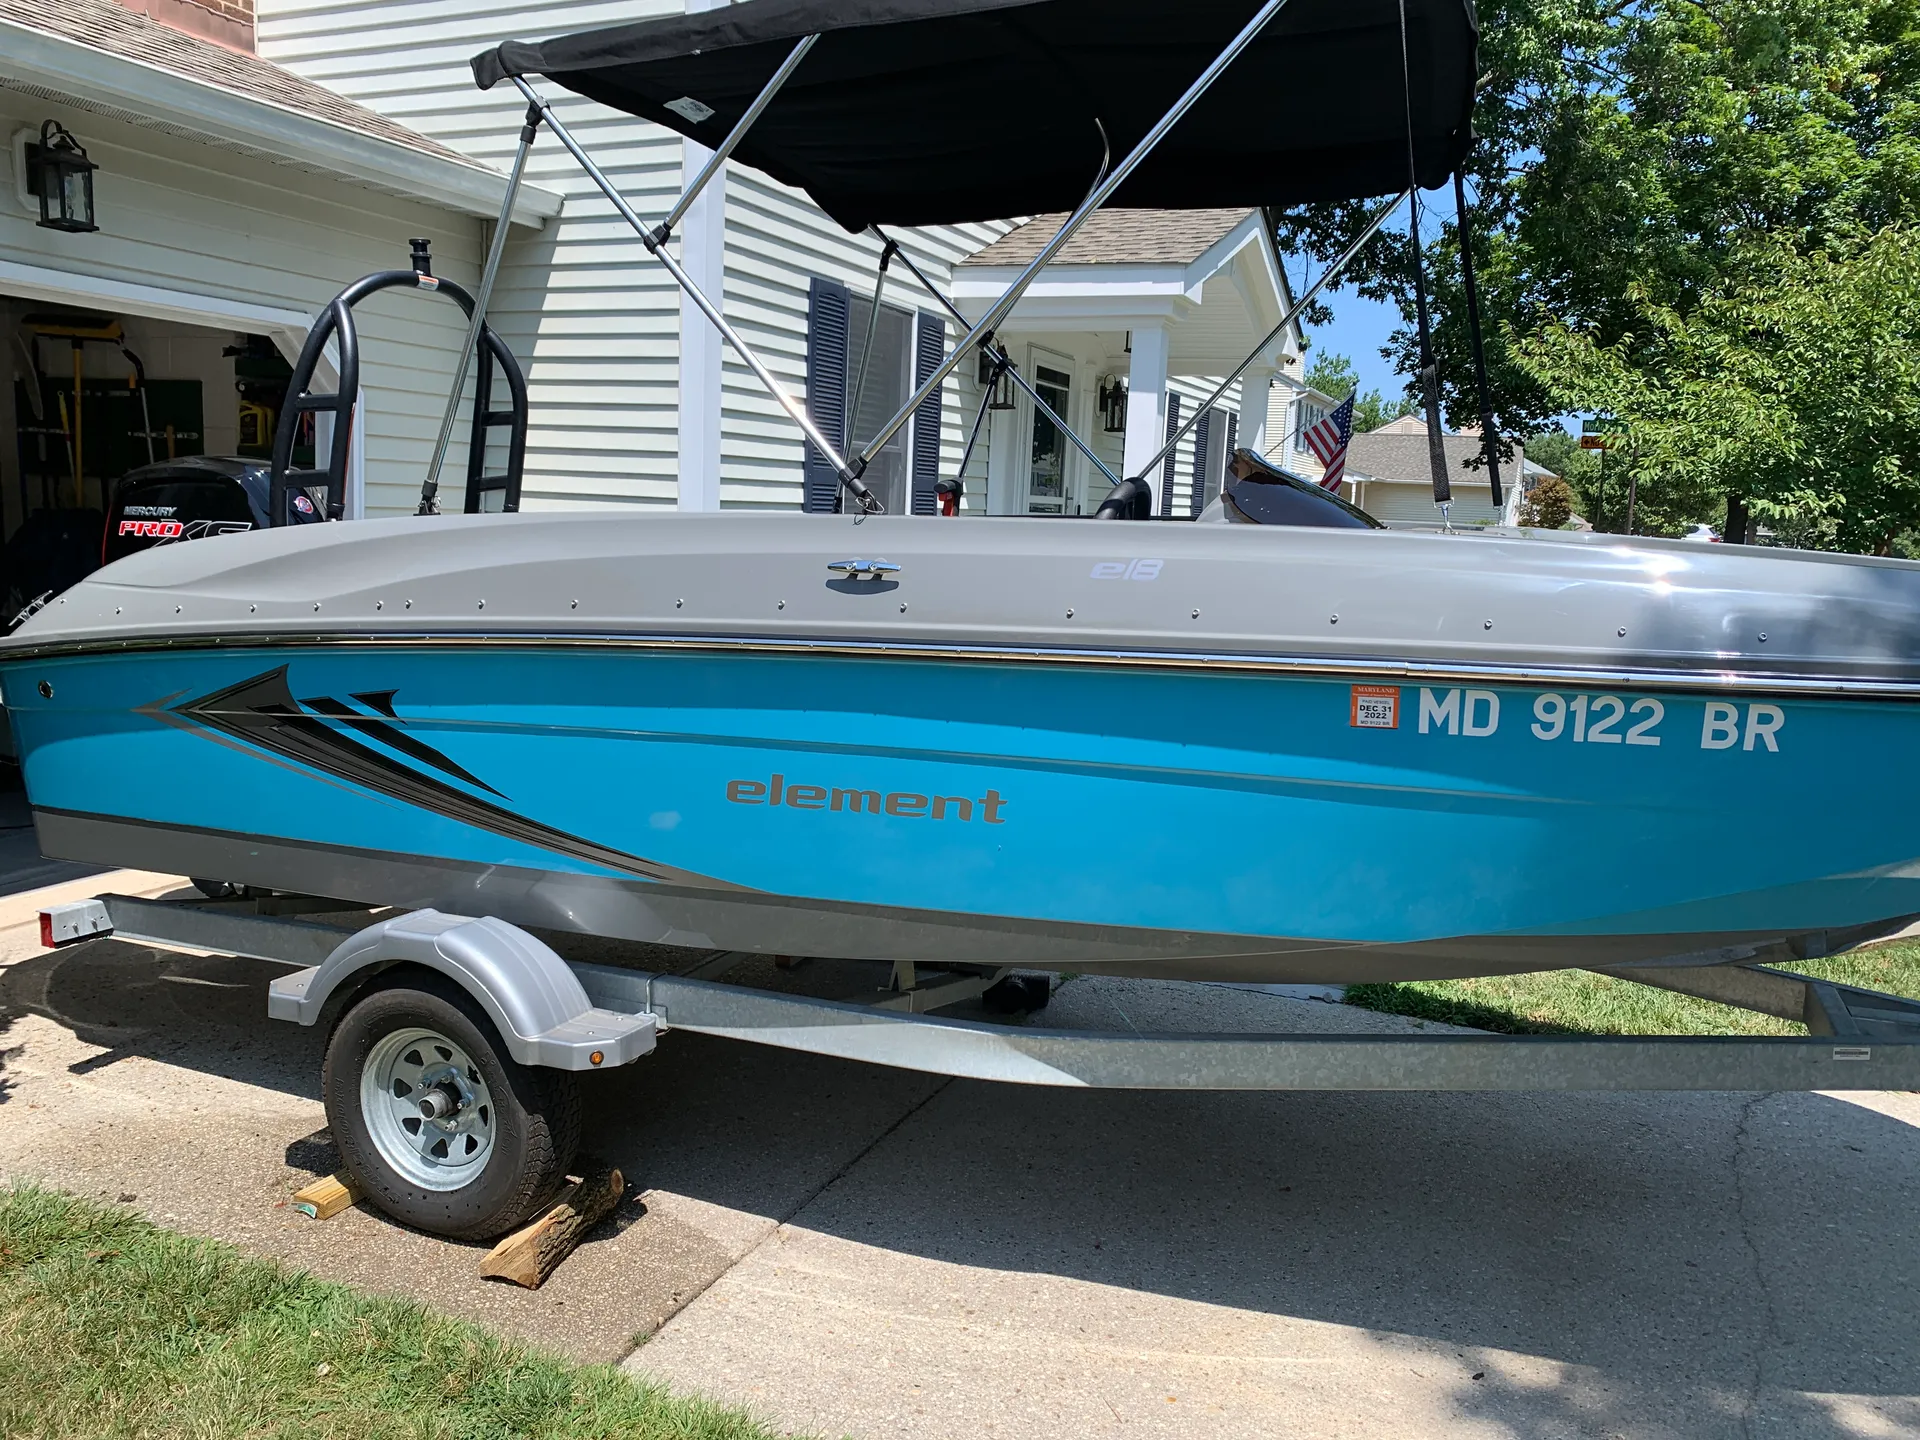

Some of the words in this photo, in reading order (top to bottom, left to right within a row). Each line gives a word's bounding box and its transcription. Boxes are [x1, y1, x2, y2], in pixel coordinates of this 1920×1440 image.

[123, 505, 177, 516] MERCURY
[119, 521, 183, 538] PRO
[1418, 687, 1500, 737] MD
[1530, 693, 1665, 746] 9122
[1700, 701, 1785, 752] BR
[726, 773, 1008, 824] element
